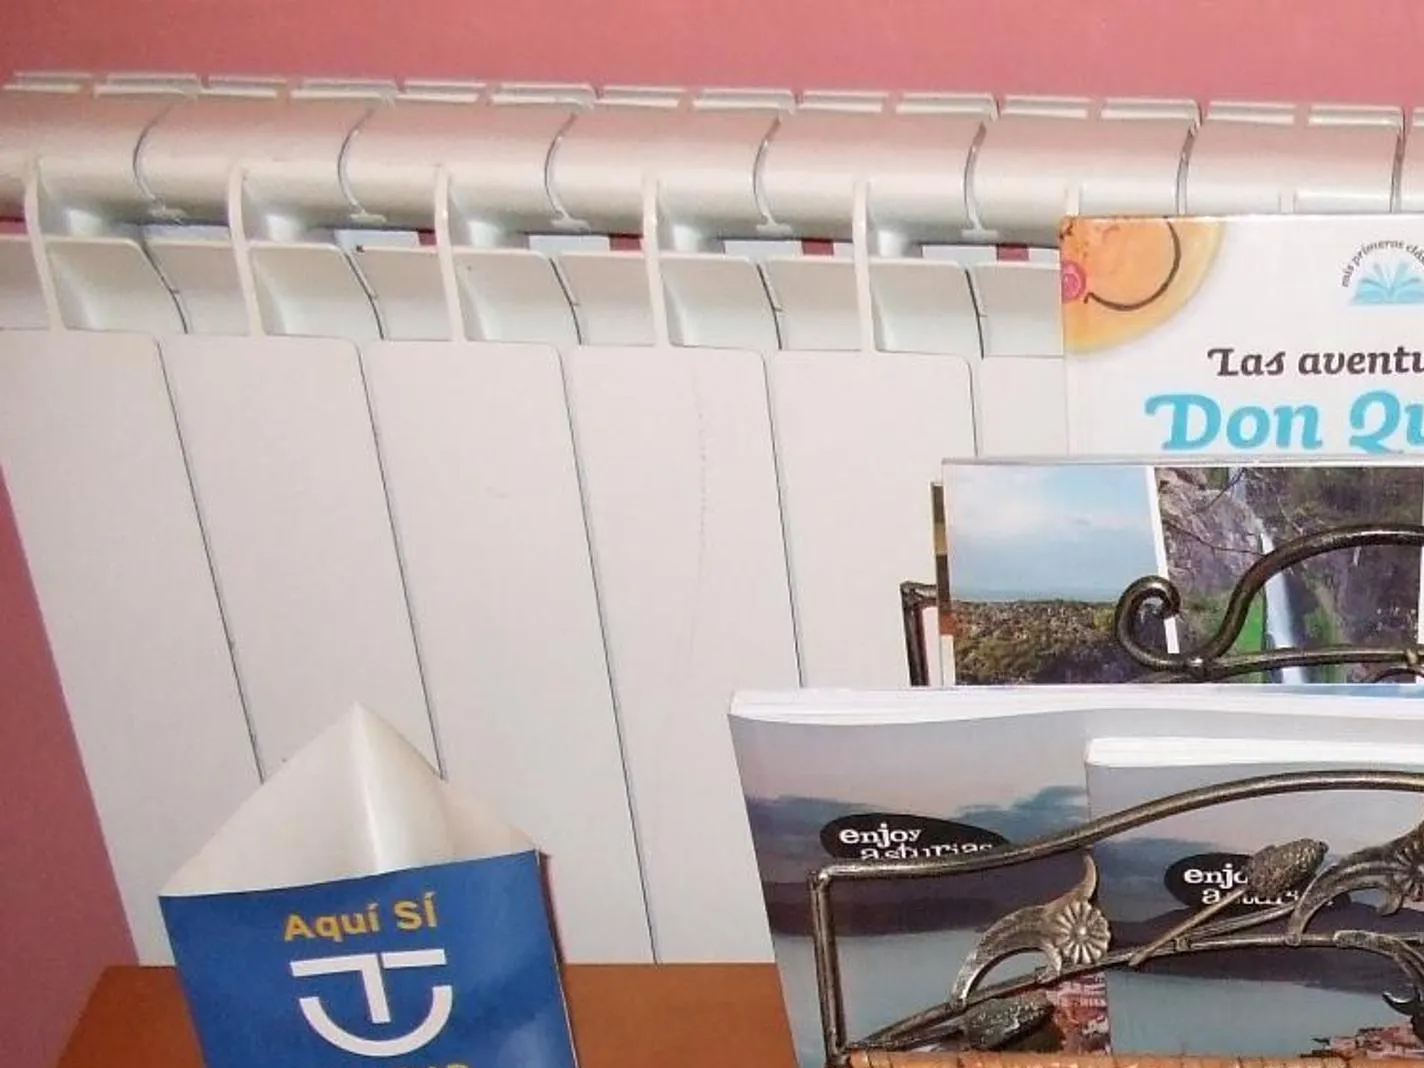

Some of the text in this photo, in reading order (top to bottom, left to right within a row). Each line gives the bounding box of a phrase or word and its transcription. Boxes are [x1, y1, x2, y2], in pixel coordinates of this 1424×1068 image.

[1342, 265, 1354, 287] mis
[1352, 240, 1404, 266] primeros
[1207, 346, 1286, 377] Las
[1144, 392, 1323, 451] Don
[838, 822, 922, 849] enjoy
[284, 902, 381, 943] Aquí
